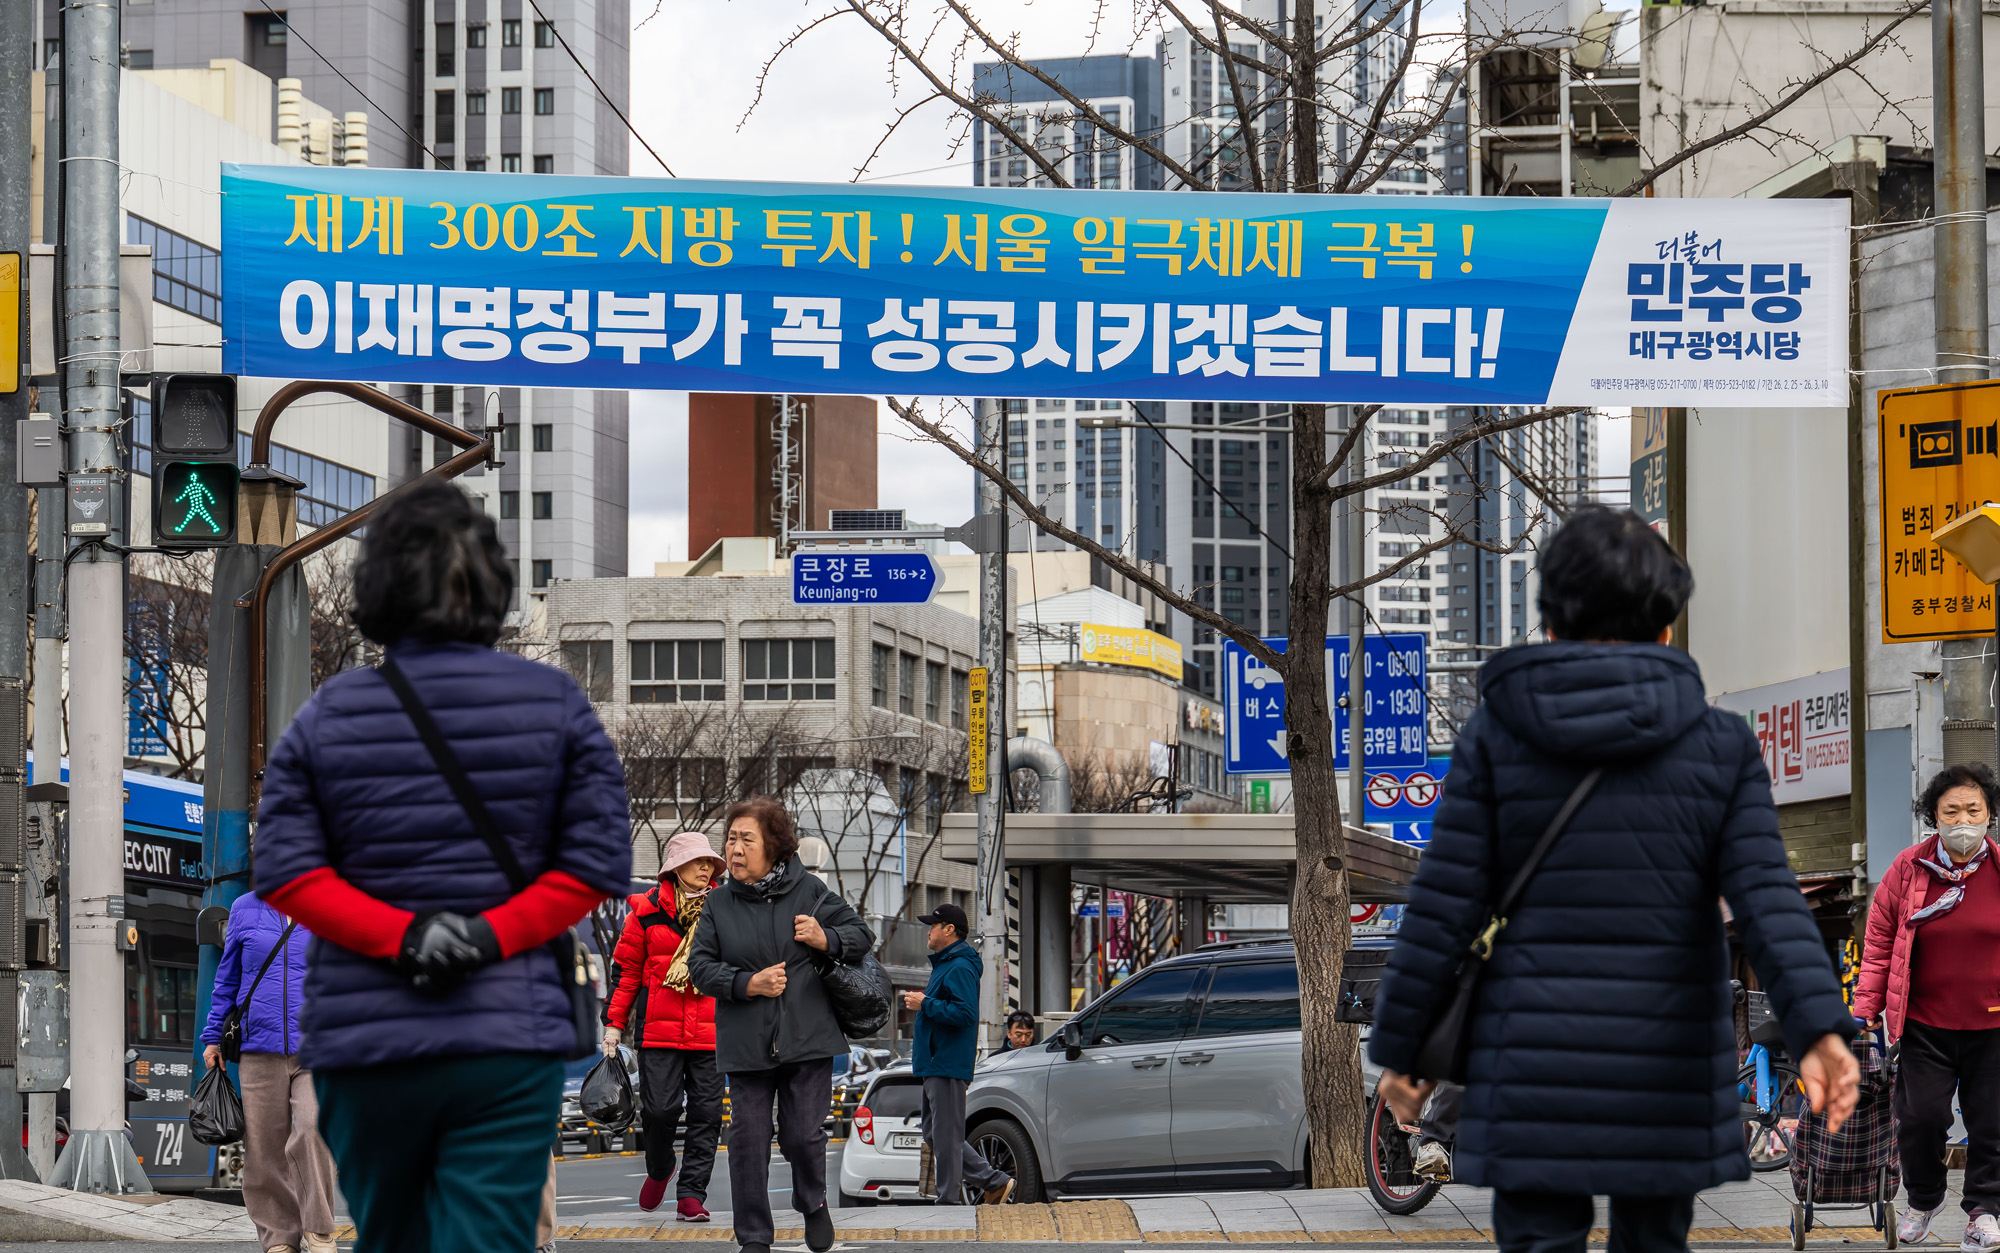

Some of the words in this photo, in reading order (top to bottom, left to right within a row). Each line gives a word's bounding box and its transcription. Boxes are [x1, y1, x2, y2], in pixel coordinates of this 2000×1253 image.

[285, 193, 404, 255] 재계
[429, 201, 598, 257] 300조
[619, 205, 741, 267] 지방
[761, 209, 878, 269] 투자
[933, 213, 1051, 273] 서울
[1072, 216, 1303, 278] 일극체제
[1327, 222, 1438, 279] 극복
[1655, 230, 1723, 264] 더불어
[1627, 262, 1812, 324] 민주당
[279, 279, 749, 366] 이재명정부가
[771, 296, 843, 370] 꼭
[866, 298, 1505, 379] 성공시키겠습니다!
[1629, 331, 1801, 361] 대구광역시당
[1590, 378, 1622, 391] 더불어민주당
[1624, 378, 1656, 391] 대구광역시당
[1656, 379, 1698, 390] 053-217-0700
[1703, 378, 1715, 390] 제작
[1715, 379, 1756, 390] 053-523-0182
[1762, 379, 1773, 391] 기간
[1643, 455, 1667, 513] 전문
[1902, 504, 1934, 536] 범죄
[799, 557, 873, 583] 큰장로
[1894, 547, 1945, 578] 카메라
[799, 585, 878, 602] Keunjang-ro
[1911, 593, 1991, 616] 중부경찰서
[1387, 650, 1420, 677] 09:00
[970, 673, 986, 687] CCTV
[1245, 697, 1280, 720] 버스
[1389, 688, 1421, 715] 19:30
[1341, 726, 1397, 756] 토공휴일
[1400, 725, 1423, 754] 제외
[1758, 700, 1803, 783] 커텐
[1804, 689, 1850, 733] 주문/제작
[143, 843, 172, 875] CITY
[180, 858, 197, 879] Fuel
[154, 1122, 185, 1166] 724
